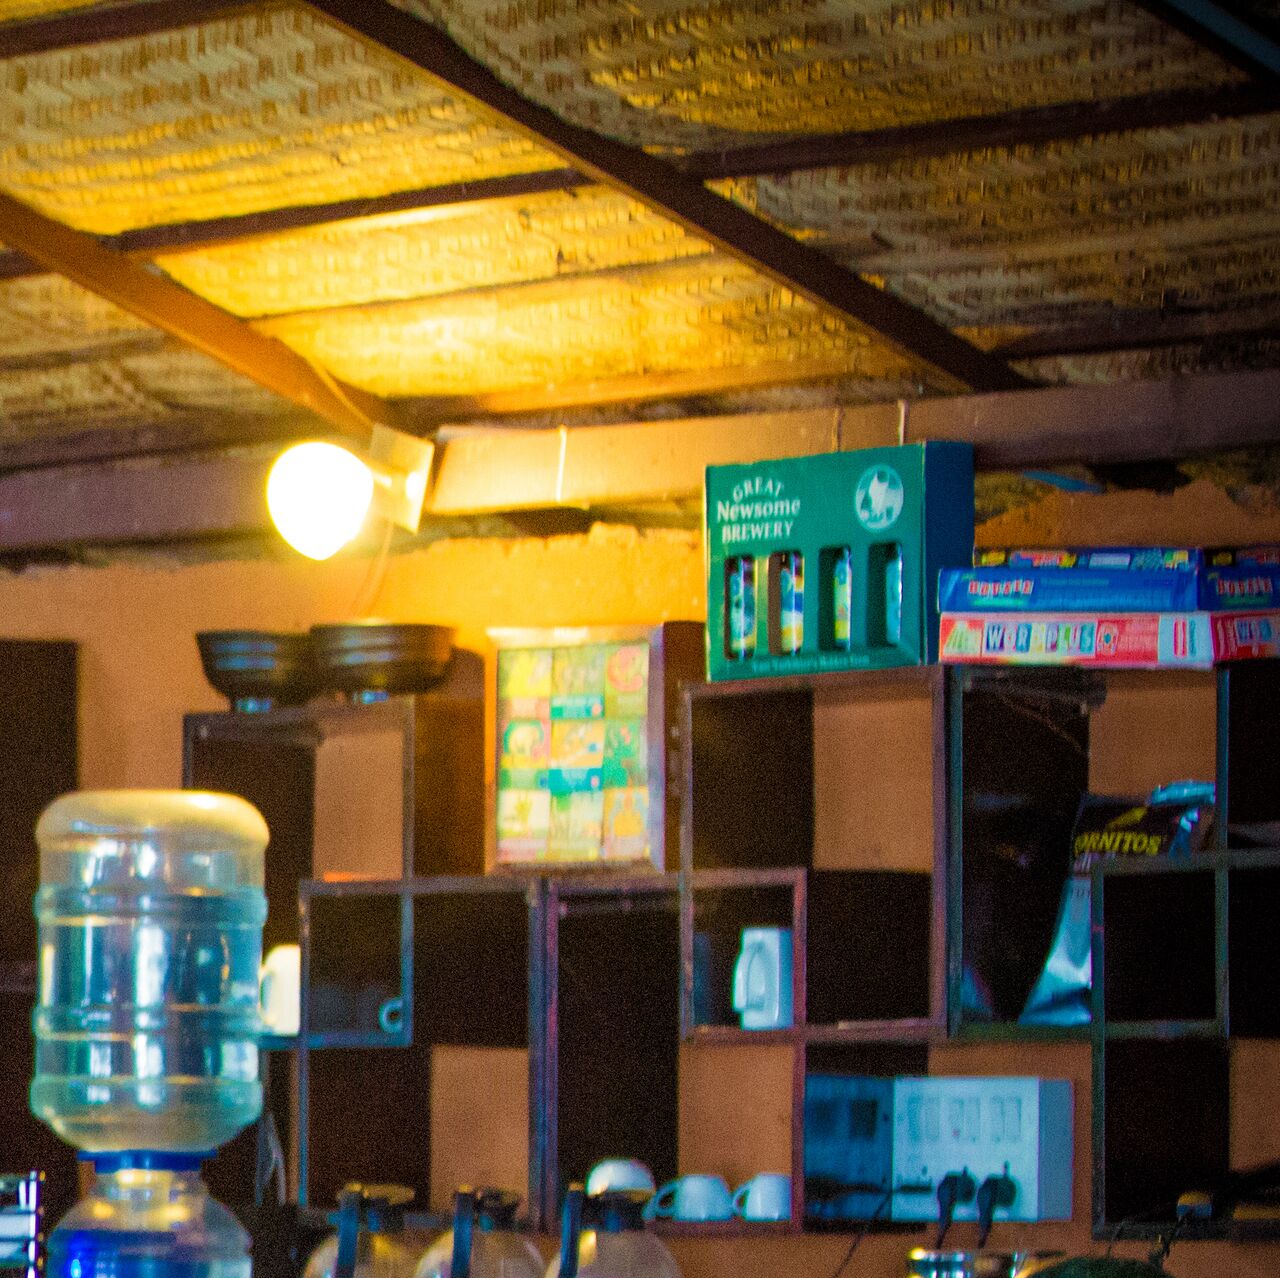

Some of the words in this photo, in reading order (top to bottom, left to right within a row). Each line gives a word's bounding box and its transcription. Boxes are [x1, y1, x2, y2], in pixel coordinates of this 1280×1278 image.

[733, 476, 784, 502] GREAT
[717, 498, 801, 522] Newsome
[722, 520, 793, 543] BREWERY
[1074, 831, 1161, 855] ORNITOS
